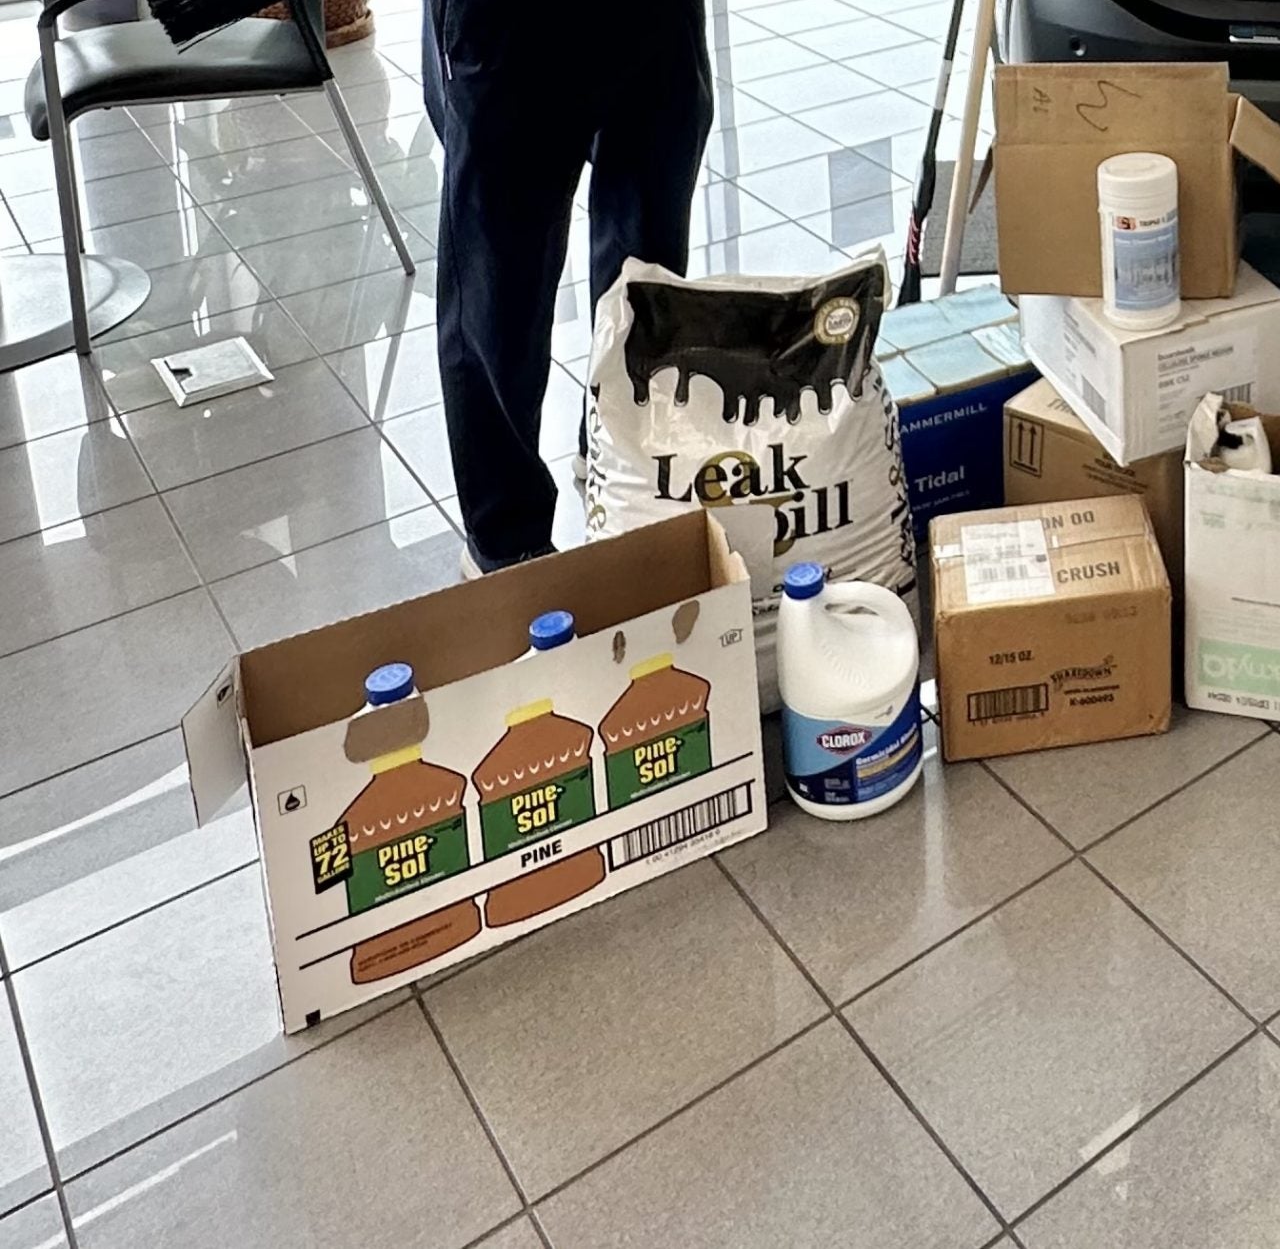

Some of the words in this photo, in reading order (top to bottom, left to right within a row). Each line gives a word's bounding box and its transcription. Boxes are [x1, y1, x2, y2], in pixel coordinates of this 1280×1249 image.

[900, 402, 988, 434] AMMERMILL
[652, 443, 811, 502] Leak
[914, 465, 965, 492] Tidal
[1057, 562, 1120, 584] CRUSH
[724, 631, 738, 645] UP
[989, 651, 1016, 665] 12/15
[821, 731, 866, 748] CLOROX
[855, 740, 900, 765] Germicidal
[639, 754, 676, 784] Sol
[517, 801, 556, 833] Sol
[313, 825, 345, 848] MAKES
[314, 841, 330, 857] UP
[332, 833, 346, 846] TO
[315, 843, 349, 875] 72
[520, 839, 563, 868] PINE
[385, 851, 426, 886] Sol
